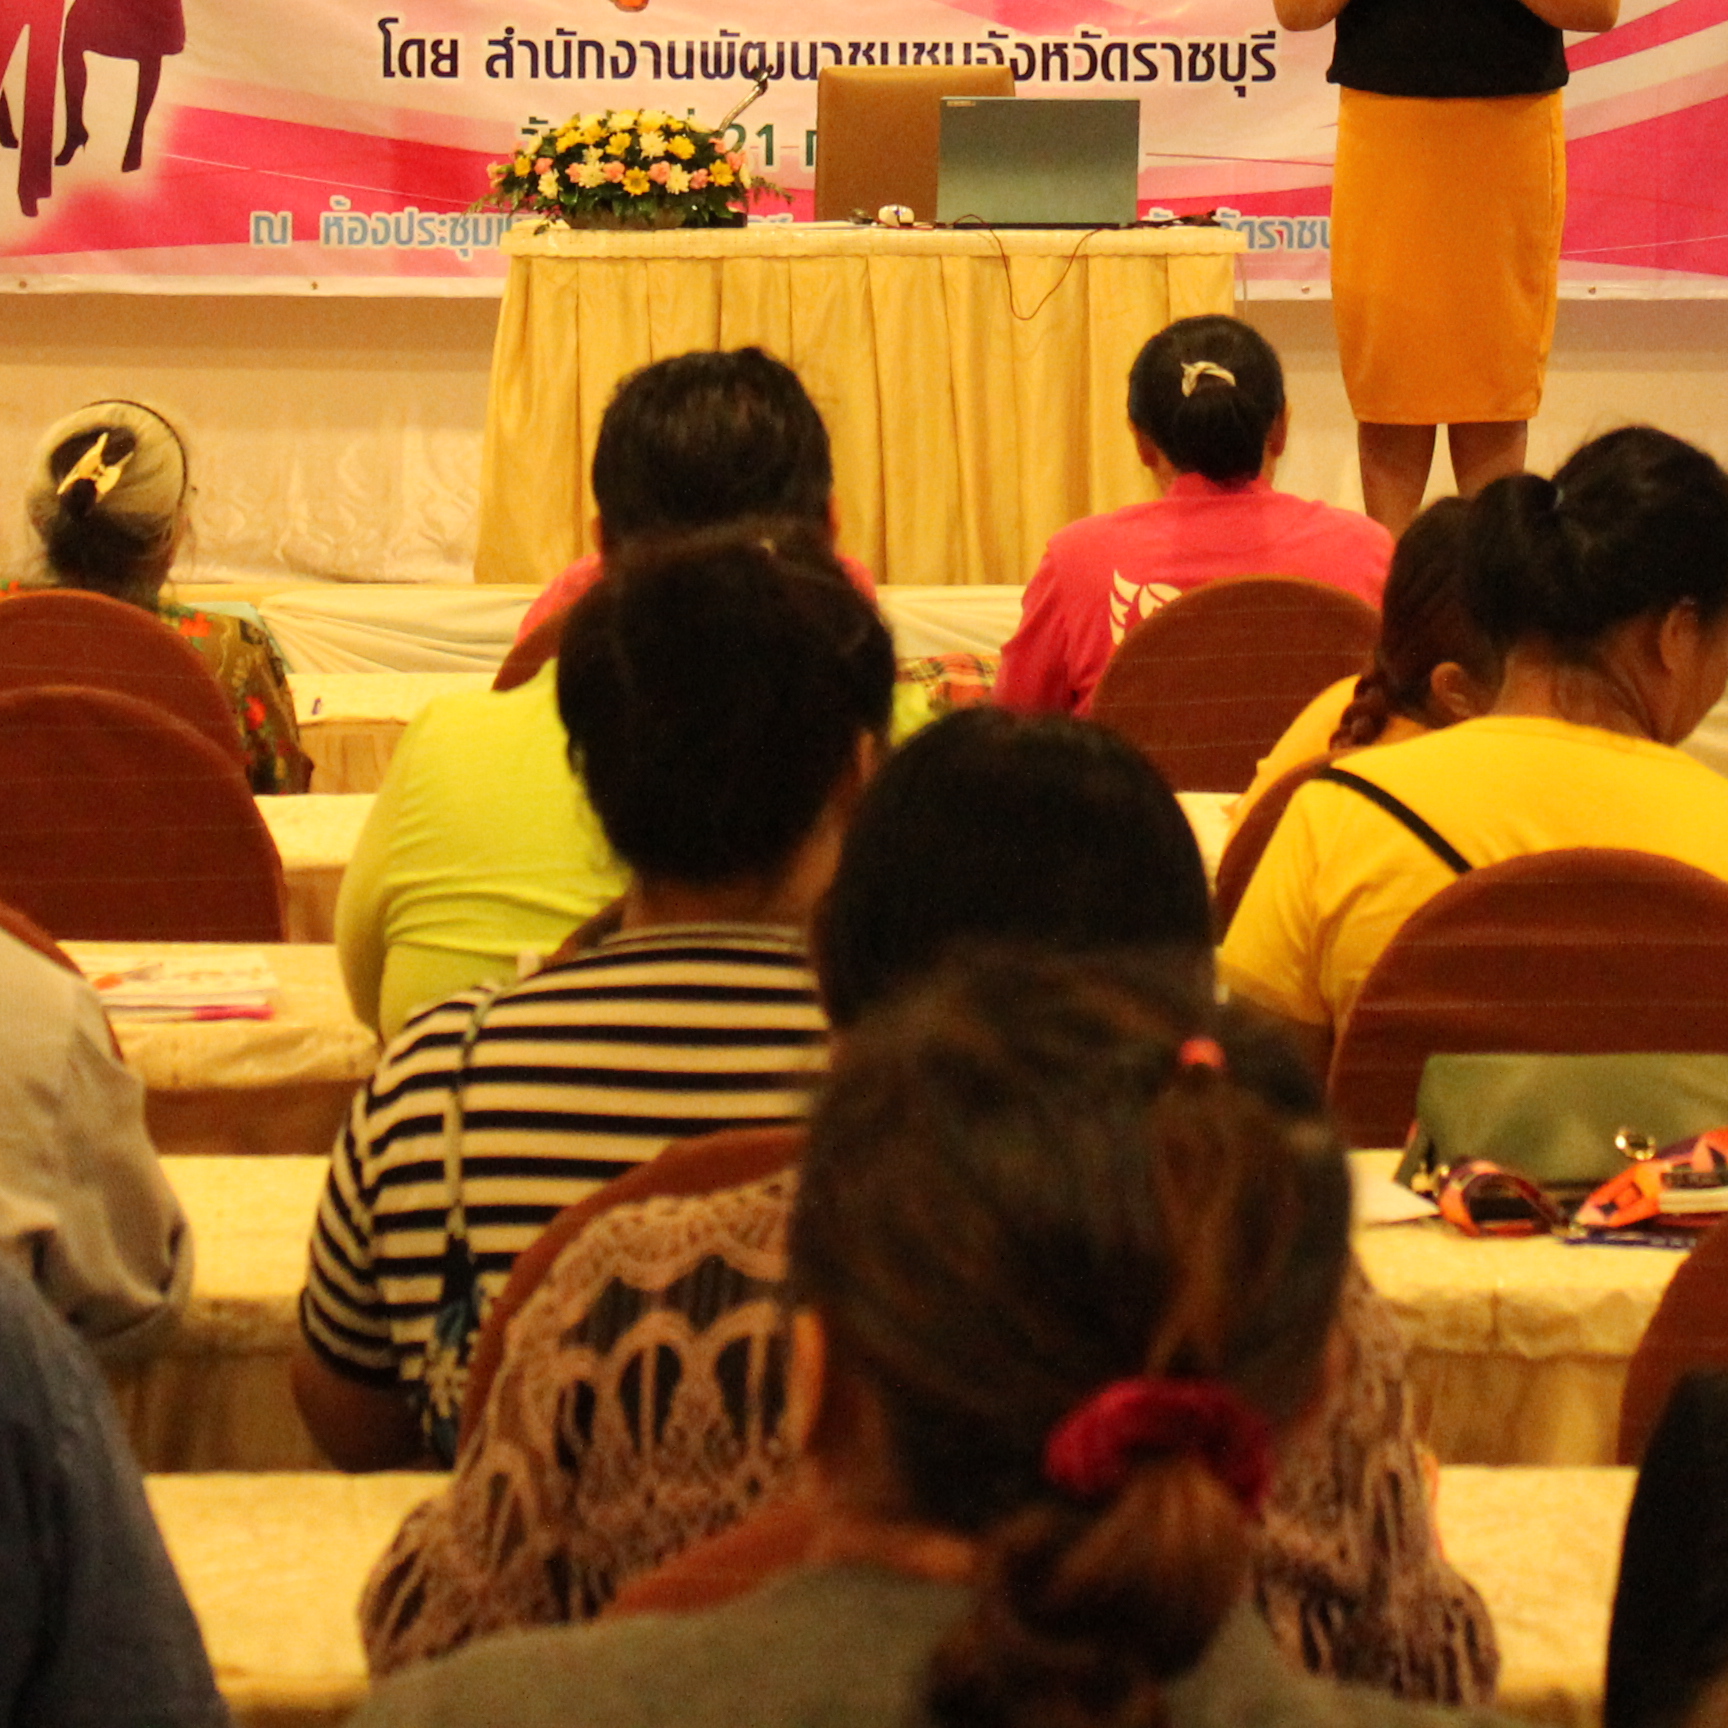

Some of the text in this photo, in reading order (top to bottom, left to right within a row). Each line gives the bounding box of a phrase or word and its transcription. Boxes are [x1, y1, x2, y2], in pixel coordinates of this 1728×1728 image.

[378, 17, 1277, 99] โดย สำนักงานพัฒนาชมชนจังหวัดราชบุรี
[253, 215, 289, 245] ณ
